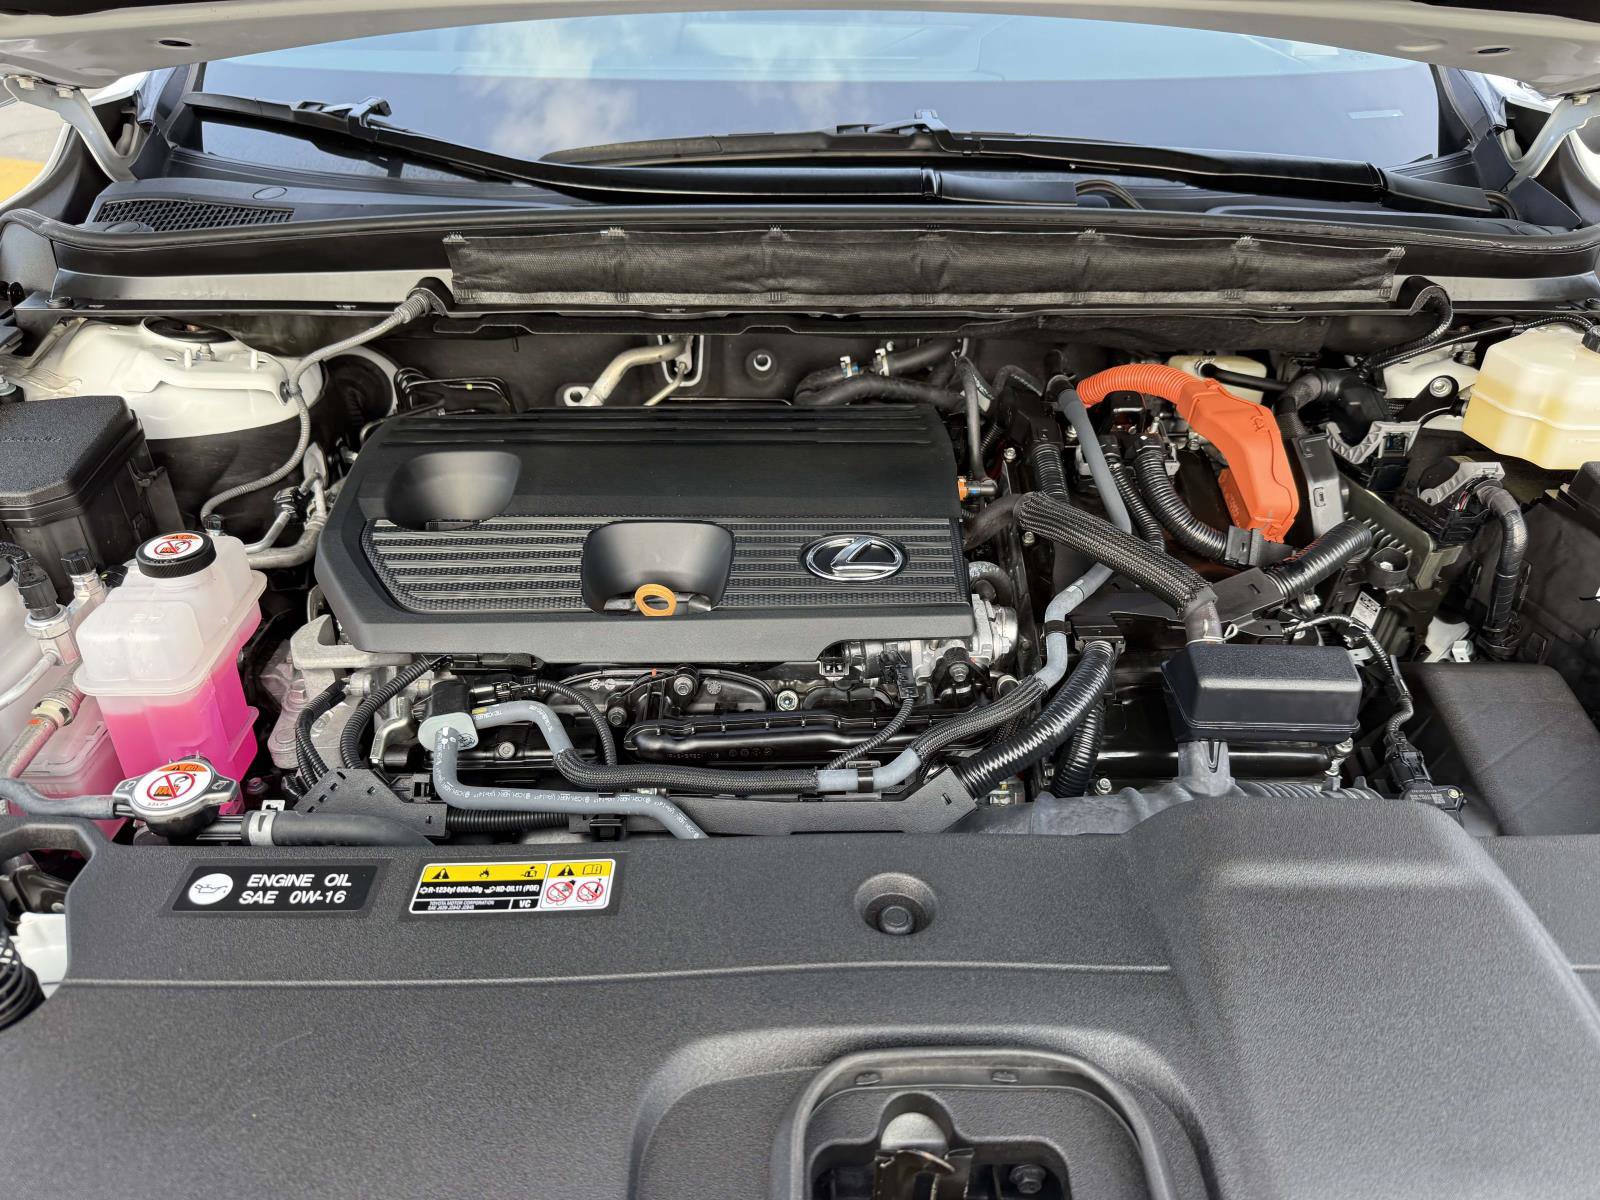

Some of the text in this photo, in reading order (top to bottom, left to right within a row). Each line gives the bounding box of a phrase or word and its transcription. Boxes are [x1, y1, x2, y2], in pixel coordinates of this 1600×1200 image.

[246, 873, 352, 887] ENGINE OIL
[238, 890, 347, 904] SAE 0W-16
[519, 900, 532, 908] VC
